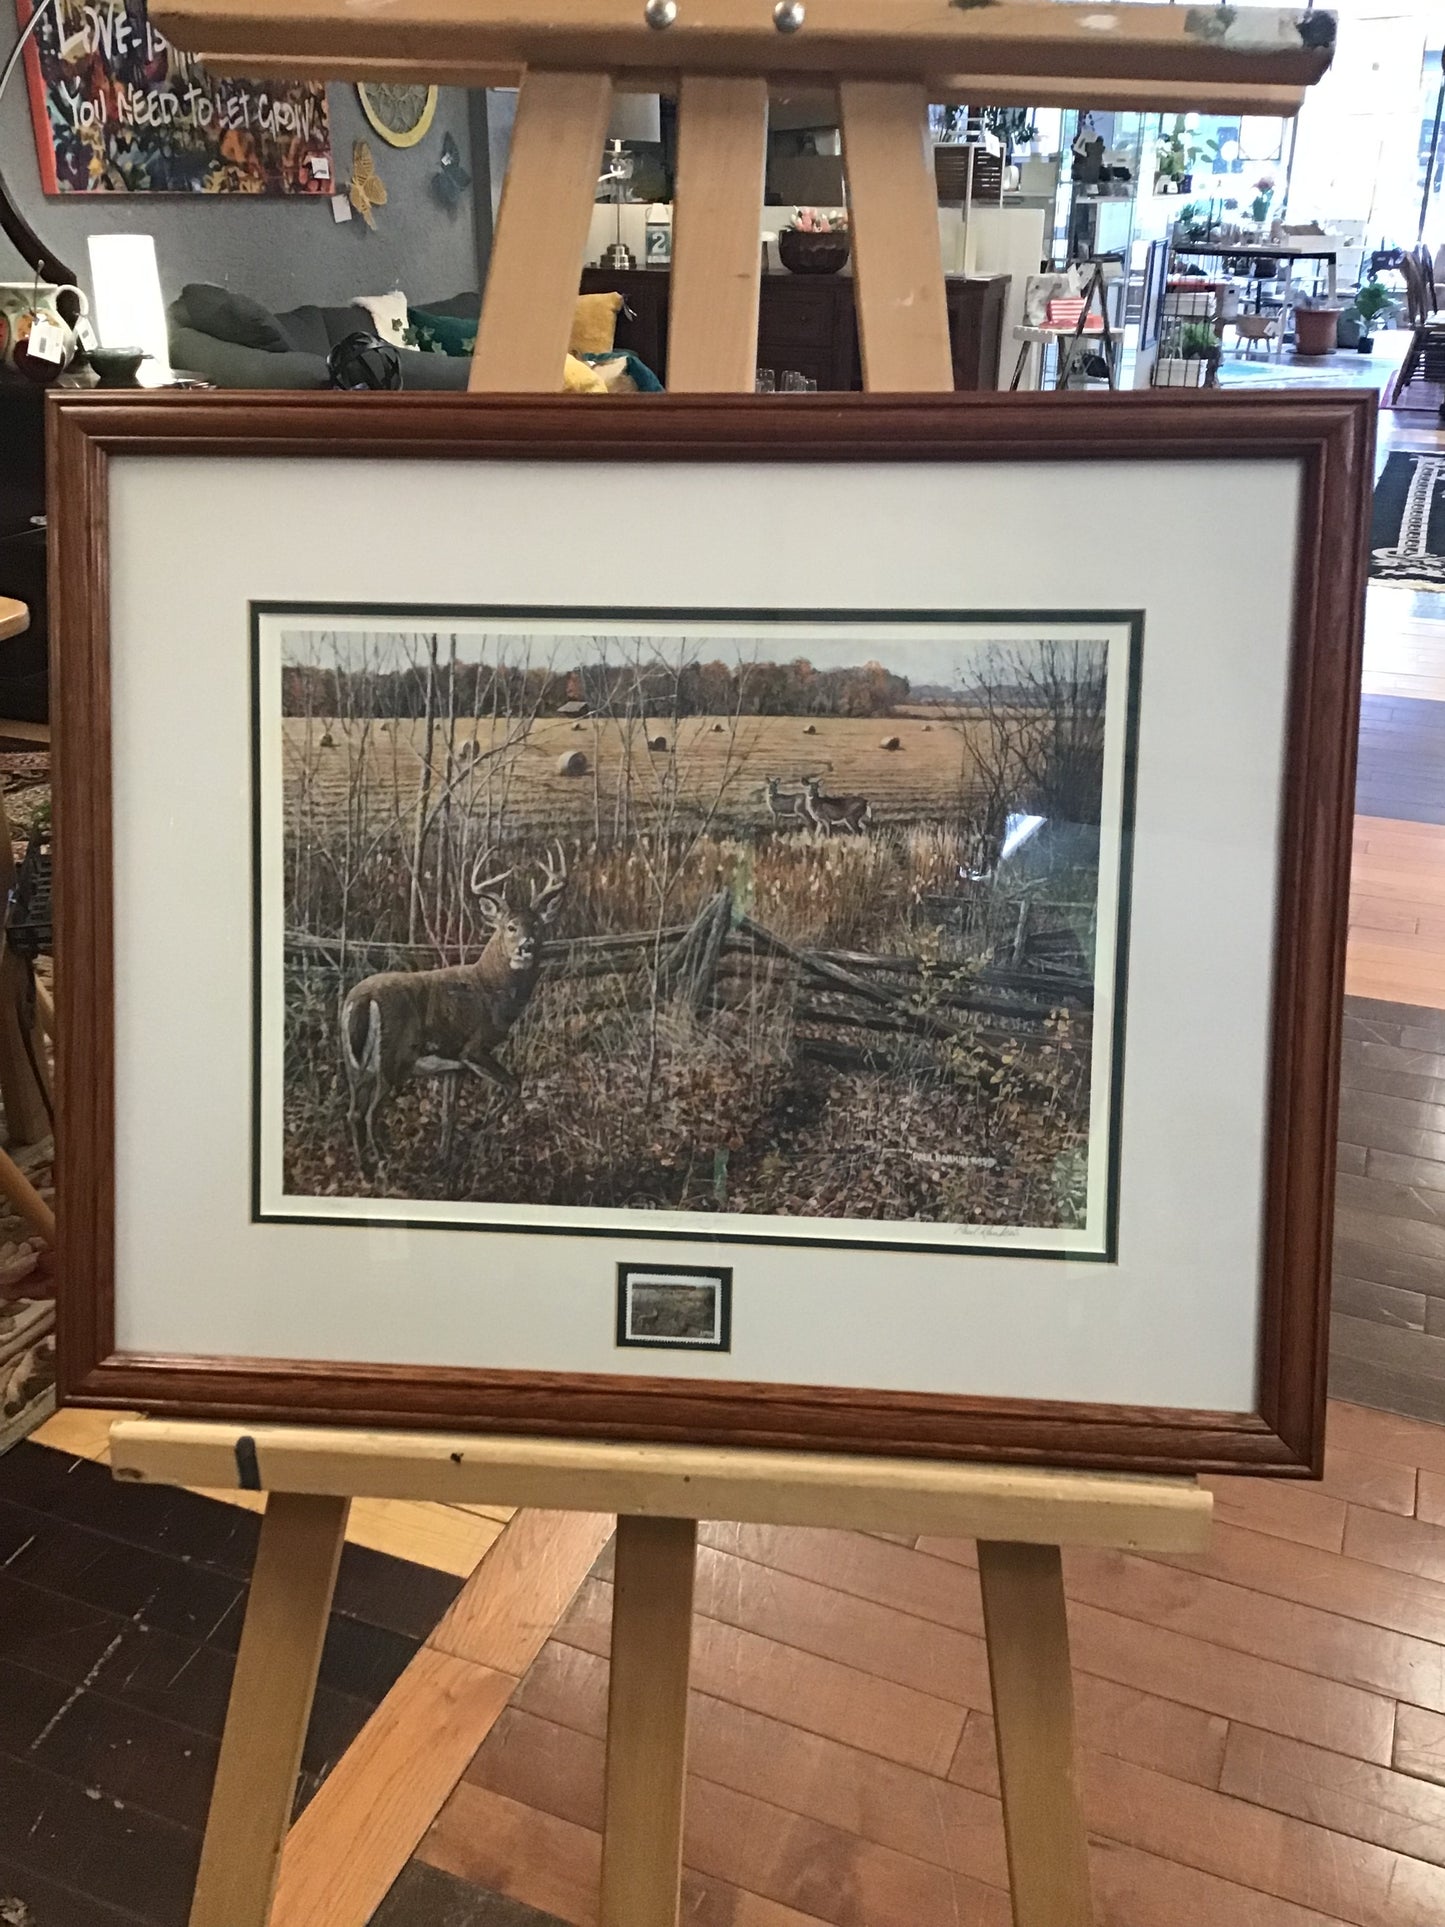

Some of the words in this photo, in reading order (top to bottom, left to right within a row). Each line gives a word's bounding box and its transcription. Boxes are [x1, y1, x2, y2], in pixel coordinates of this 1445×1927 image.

[60, 75, 107, 129] YOU
[117, 82, 179, 127] NEED
[183, 82, 213, 128] TO
[216, 88, 250, 130] LET
[652, 231, 666, 254] 2
